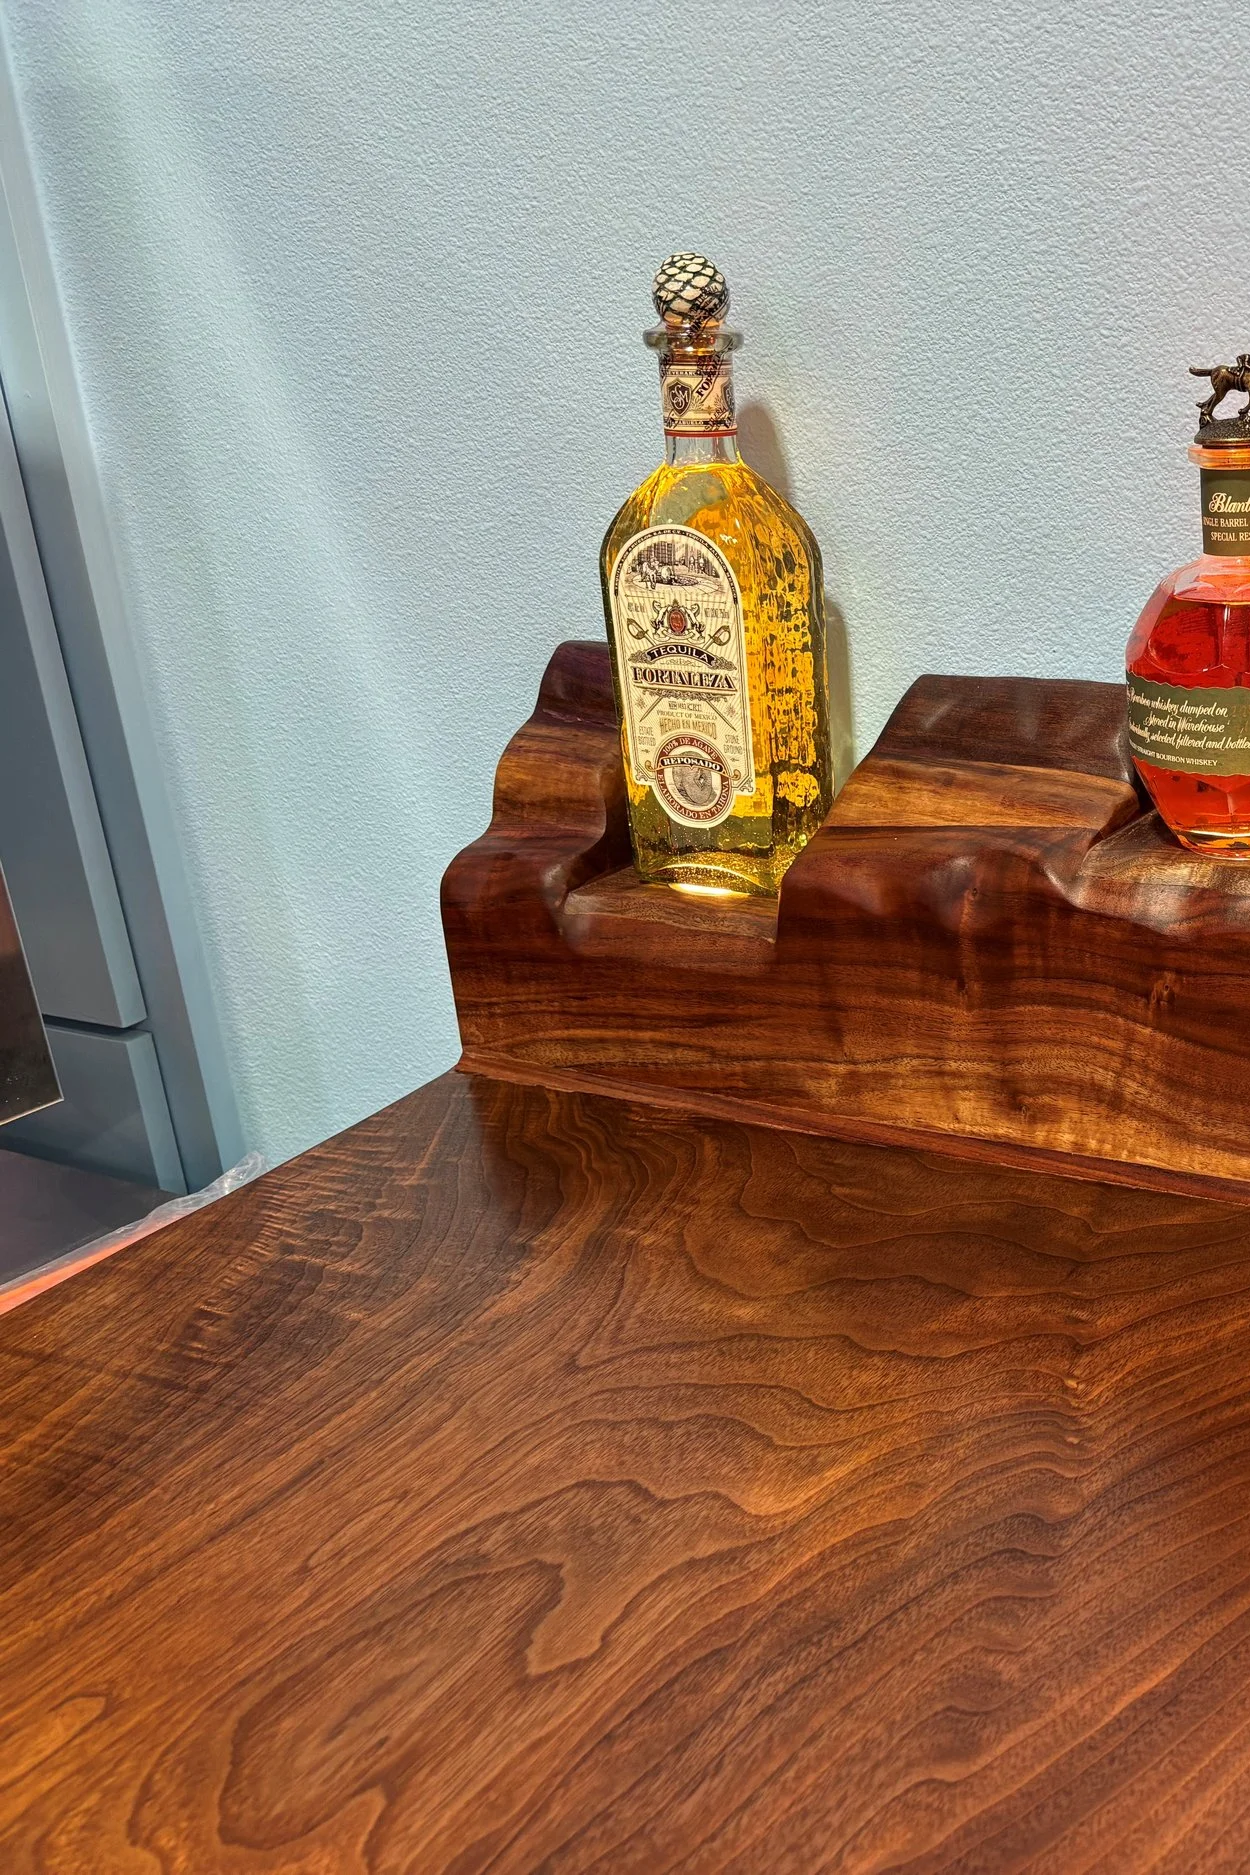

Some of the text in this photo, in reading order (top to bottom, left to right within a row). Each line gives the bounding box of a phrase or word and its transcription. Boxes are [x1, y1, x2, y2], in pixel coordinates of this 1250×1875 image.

[1220, 518, 1248, 528] BARREL
[1210, 532, 1237, 541] SPECIAL
[652, 645, 709, 662] TEQUILA
[632, 667, 736, 691] FORTALEZA
[1151, 696, 1180, 718] whiskey
[1180, 700, 1216, 718] dumped
[1215, 706, 1228, 717] on
[660, 718, 717, 740] HECHO EN MEXICO
[1168, 717, 1177, 730] in
[1177, 717, 1225, 732] Warehouse
[663, 737, 718, 760] 100% DE AGAVE
[1175, 734, 1206, 750] filtered
[1206, 736, 1226, 750] and
[663, 757, 720, 771] REPOSADO
[1156, 752, 1185, 763] BOURBON
[1186, 757, 1218, 766] WHISKEY
[658, 774, 729, 819] ELABORADO EN TAHONA
